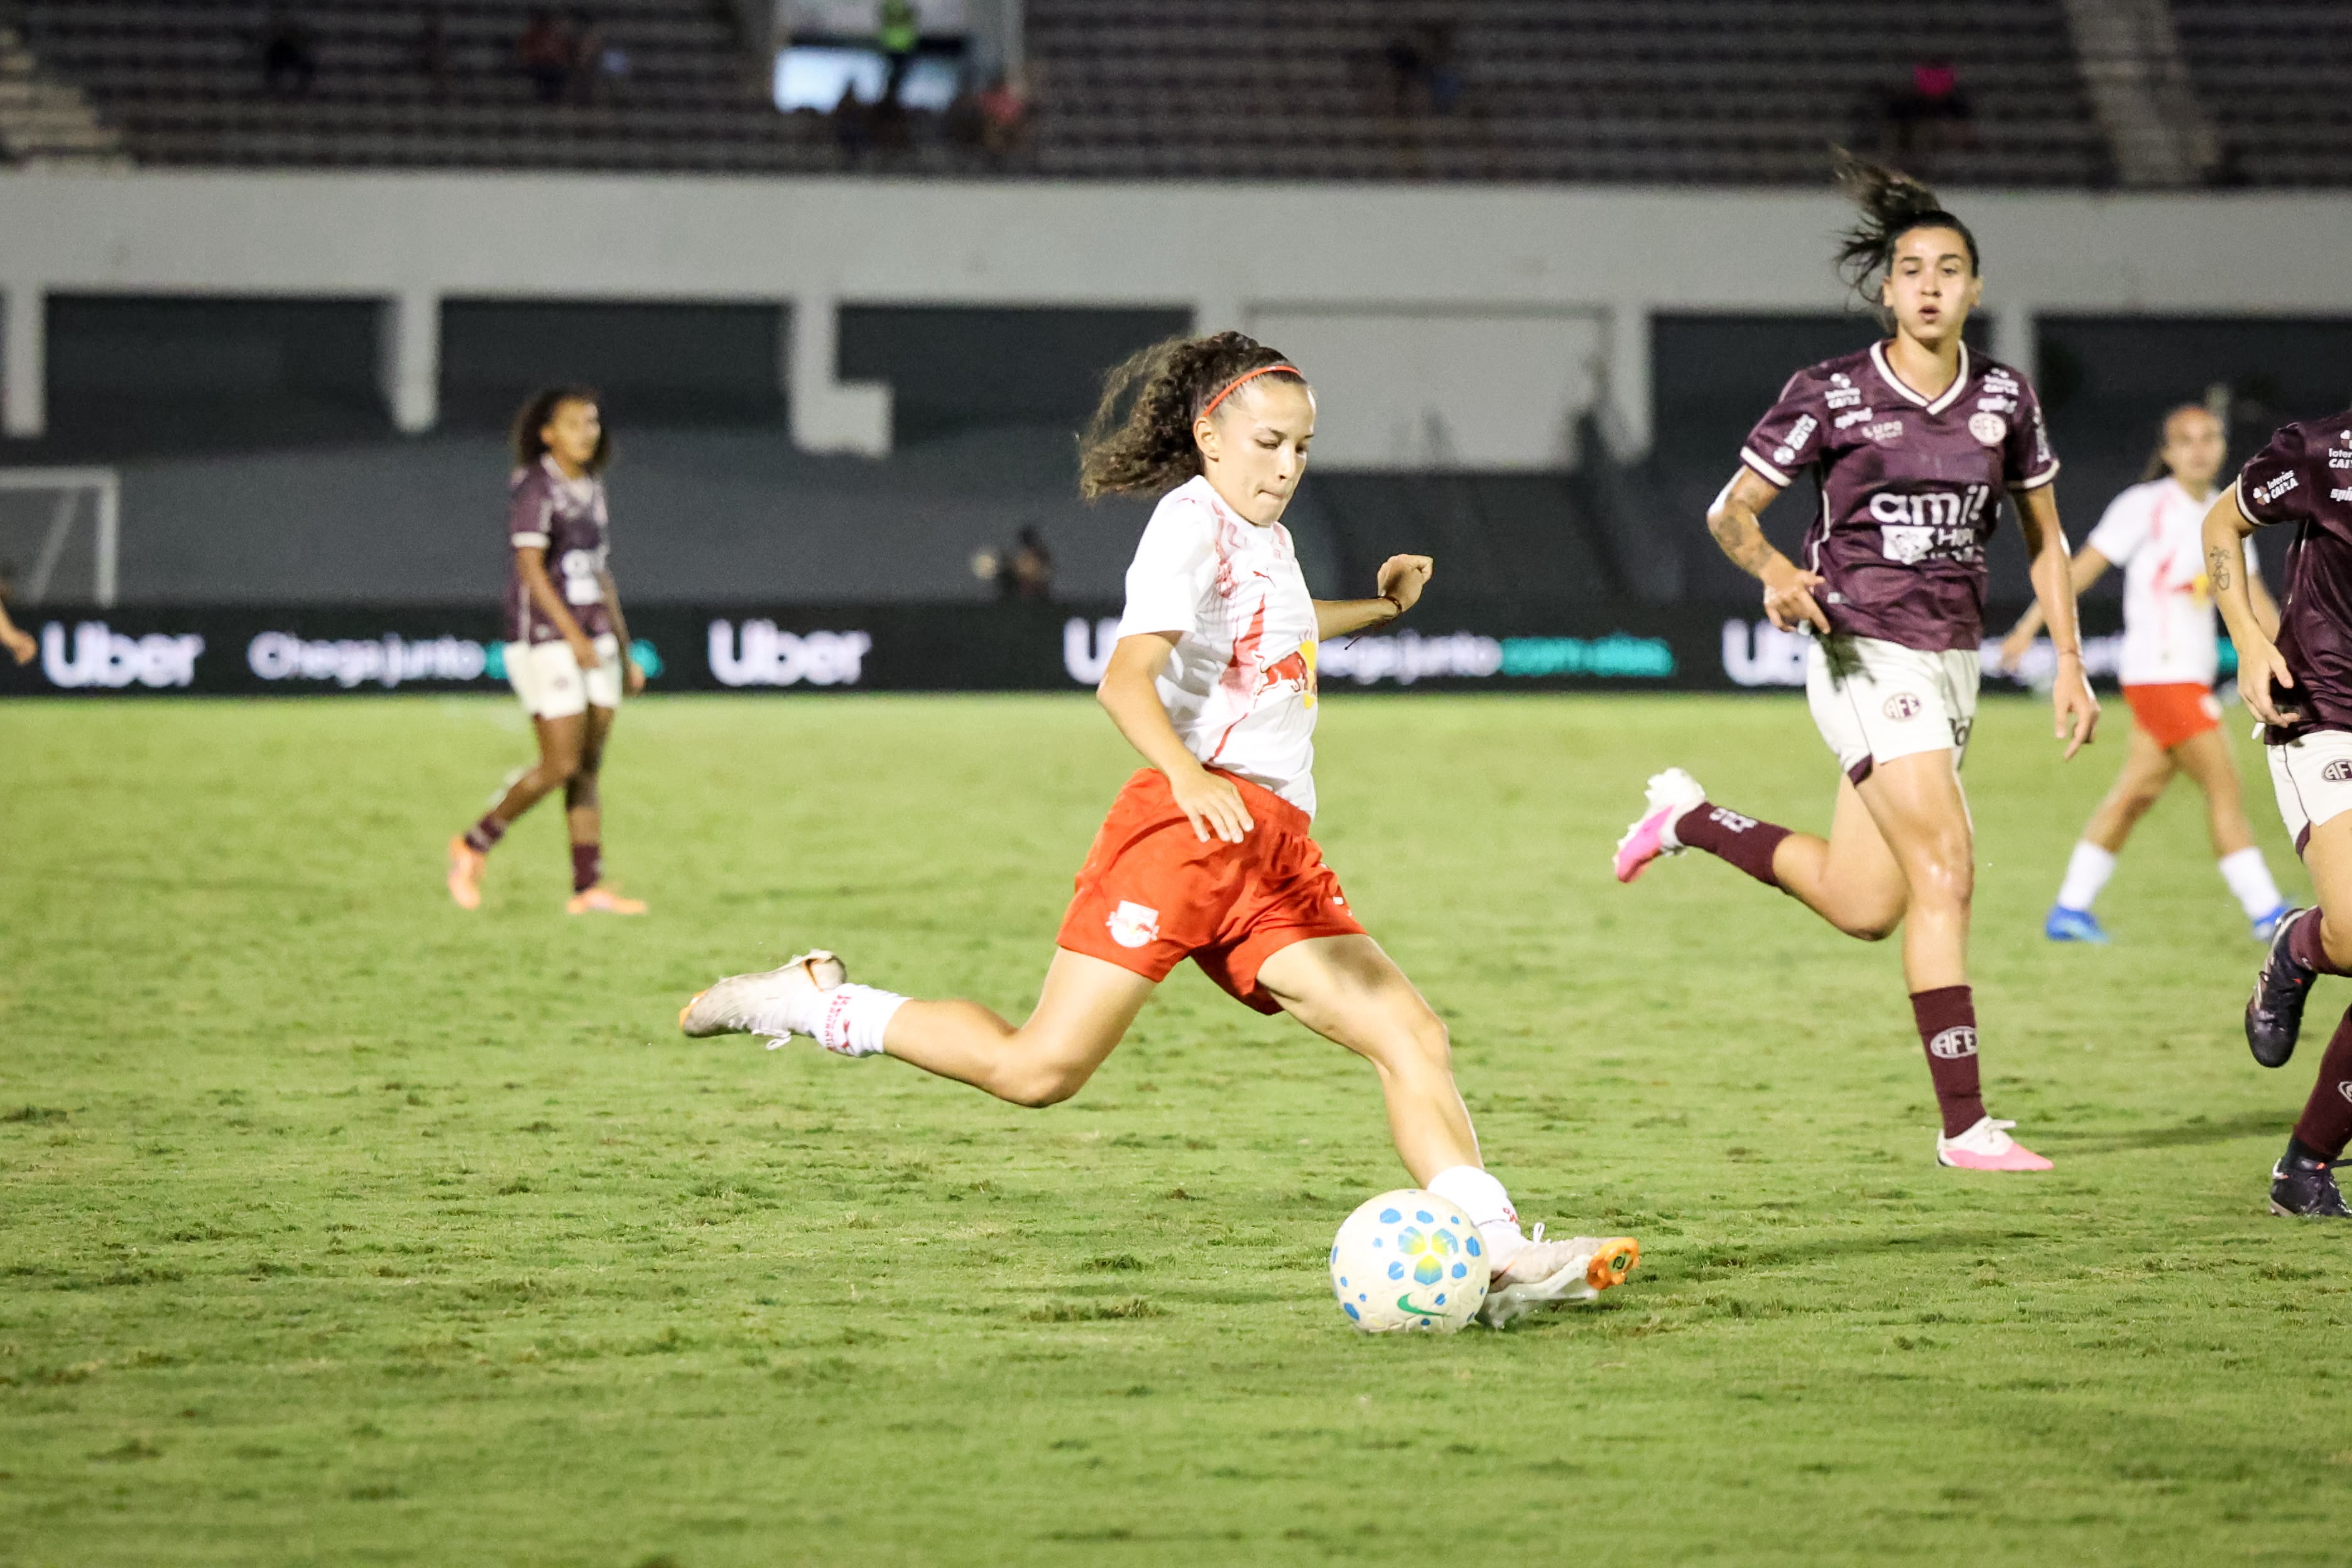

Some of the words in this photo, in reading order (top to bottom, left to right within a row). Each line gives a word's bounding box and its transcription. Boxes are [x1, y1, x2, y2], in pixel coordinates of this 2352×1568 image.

[2329, 448, 2352, 457] loter
[2329, 459, 2352, 469] CAI
[2270, 477, 2299, 499] CAIXA
[2330, 486, 2352, 501] spi
[42, 620, 204, 687] Uber
[708, 618, 872, 687] Uber
[1722, 618, 1807, 687] Ub
[1932, 1030, 1977, 1055] AFE
